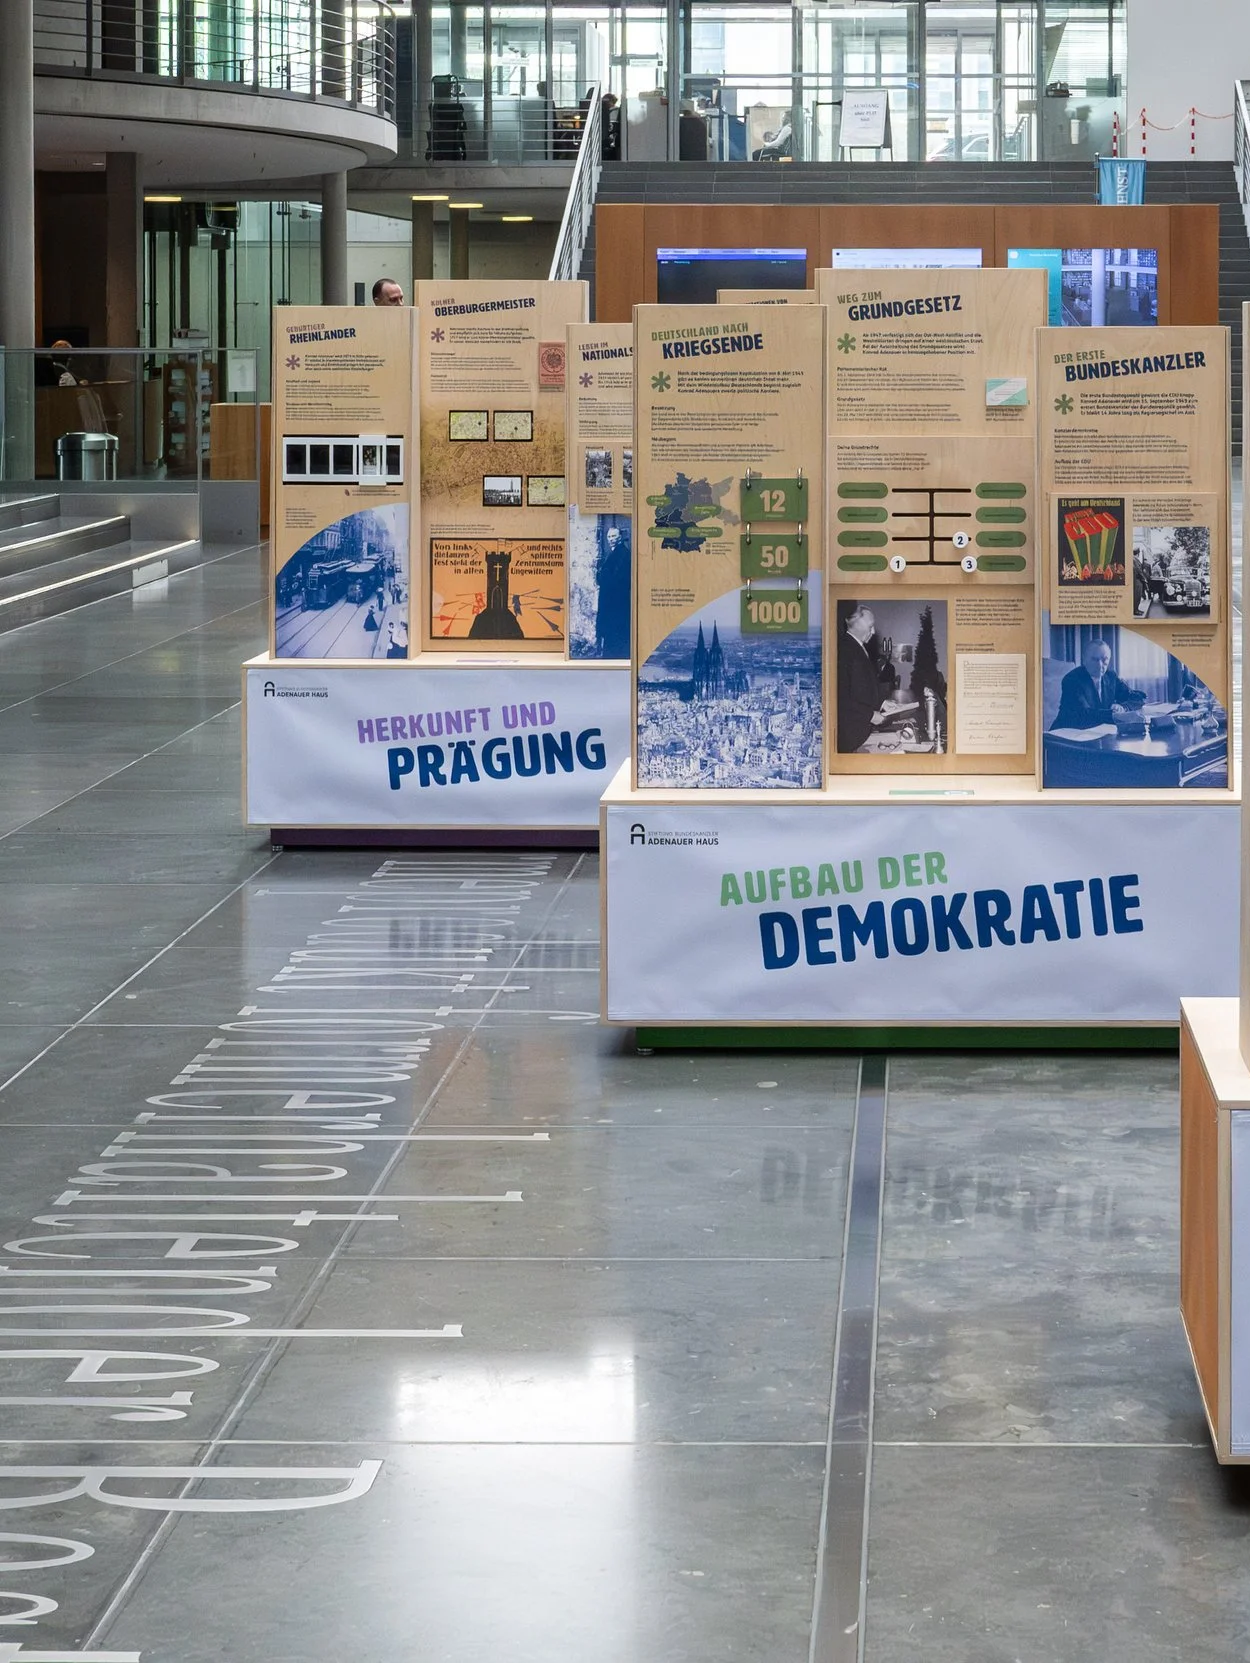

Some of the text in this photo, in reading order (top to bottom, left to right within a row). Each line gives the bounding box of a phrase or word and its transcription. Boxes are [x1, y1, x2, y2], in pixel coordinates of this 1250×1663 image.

[837, 291, 882, 304] WEG ZUM
[848, 295, 962, 321] GRUNDGESETZ
[652, 322, 748, 342] DEUTSCHLAND NACH
[662, 334, 764, 360] KRIEGSENDE
[1054, 350, 1106, 364] DER ERSTE
[1065, 351, 1206, 382] BUNDESKANZLER
[760, 490, 786, 512] 12
[957, 536, 964, 545] 2
[760, 545, 789, 568] 50
[966, 560, 973, 569] 3
[747, 601, 800, 624] 1000
[312, 690, 328, 698] HAUS
[358, 700, 556, 744] HERKUNFT UND
[387, 728, 606, 790] PRÄGUNG
[648, 838, 719, 846] ADENAUER HAUS
[720, 851, 948, 906] AUFBAU DER
[759, 873, 1144, 970] DEMOKRATIE
